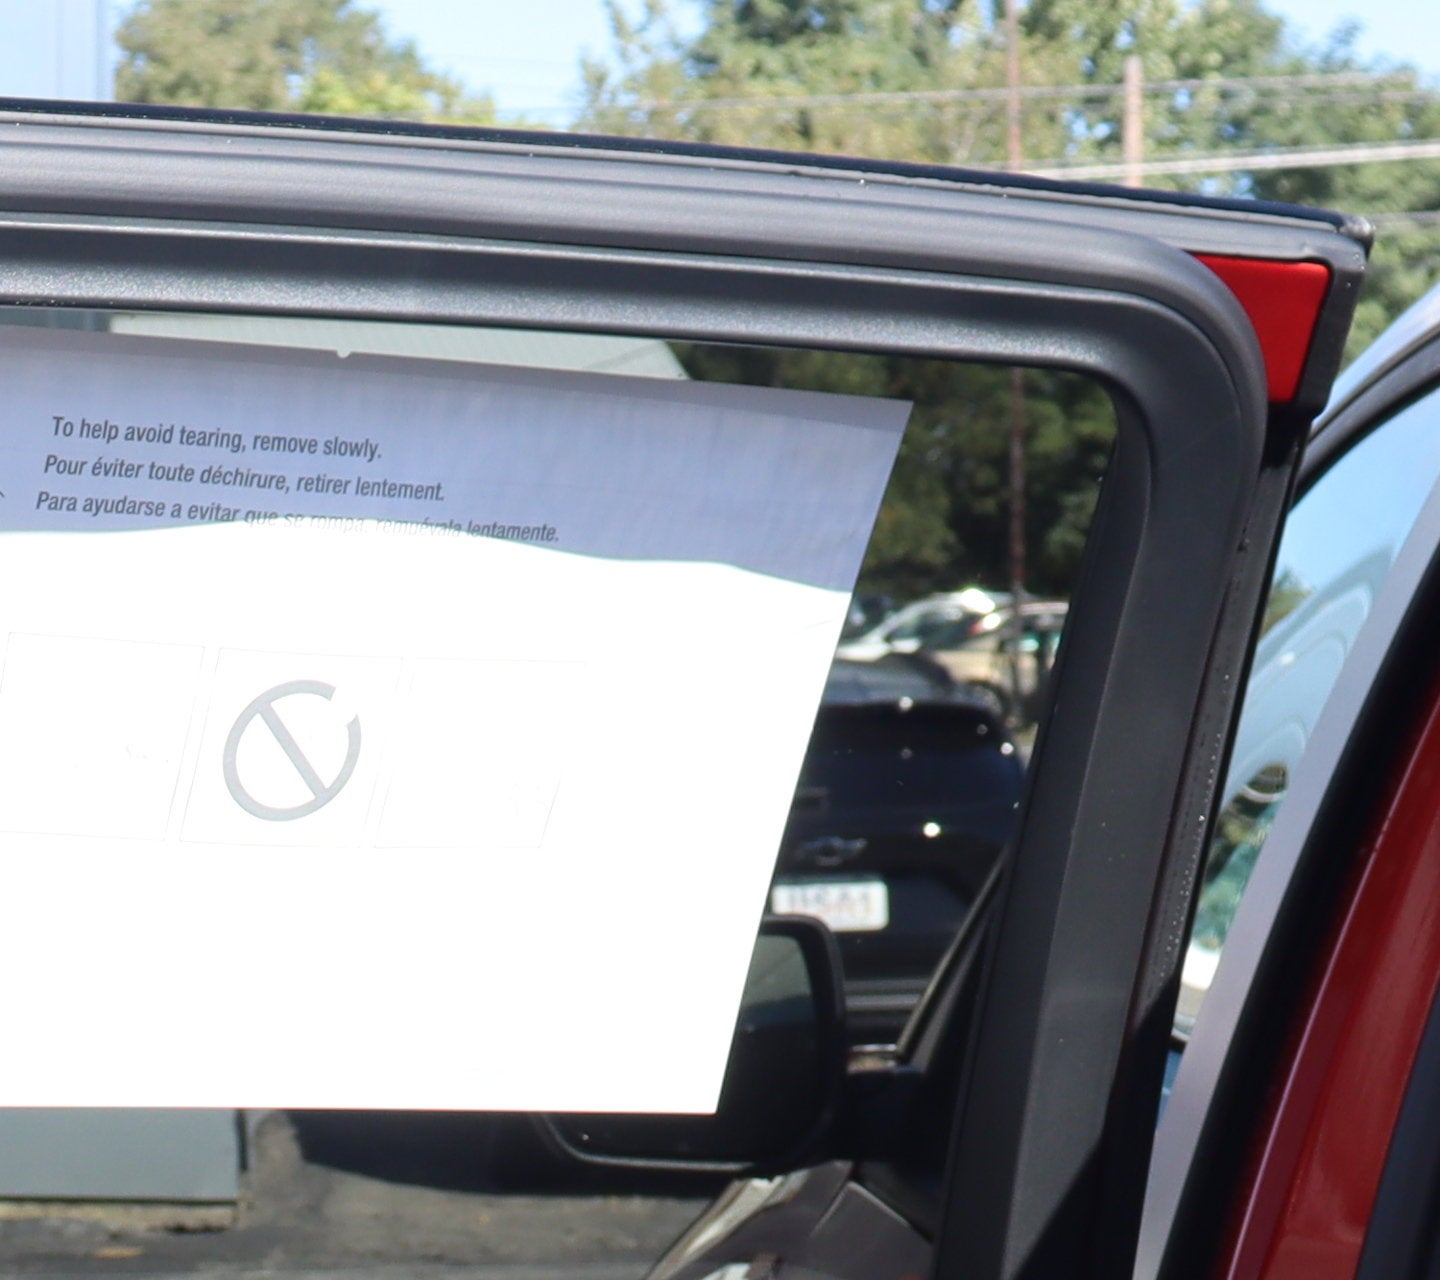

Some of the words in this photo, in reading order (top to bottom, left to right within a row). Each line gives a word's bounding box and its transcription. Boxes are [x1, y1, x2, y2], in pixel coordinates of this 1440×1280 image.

[52, 415, 74, 437] To
[78, 418, 120, 444] help
[124, 424, 174, 444] avoid
[178, 426, 247, 452] tearing,
[252, 434, 319, 455] remove
[323, 436, 382, 462] slowly.
[44, 454, 88, 475] Pour
[91, 456, 144, 478] éviter
[147, 461, 196, 482] toute
[199, 464, 291, 494] déchirure,
[296, 474, 352, 494] retirer
[355, 476, 445, 501] lentement.
[35, 490, 78, 512] Para
[81, 496, 166, 517] ayudarse
[170, 503, 182, 518] a
[187, 502, 241, 522] evitar
[244, 508, 279, 530] que
[284, 513, 304, 528] se
[466, 520, 560, 543] lentamente.
